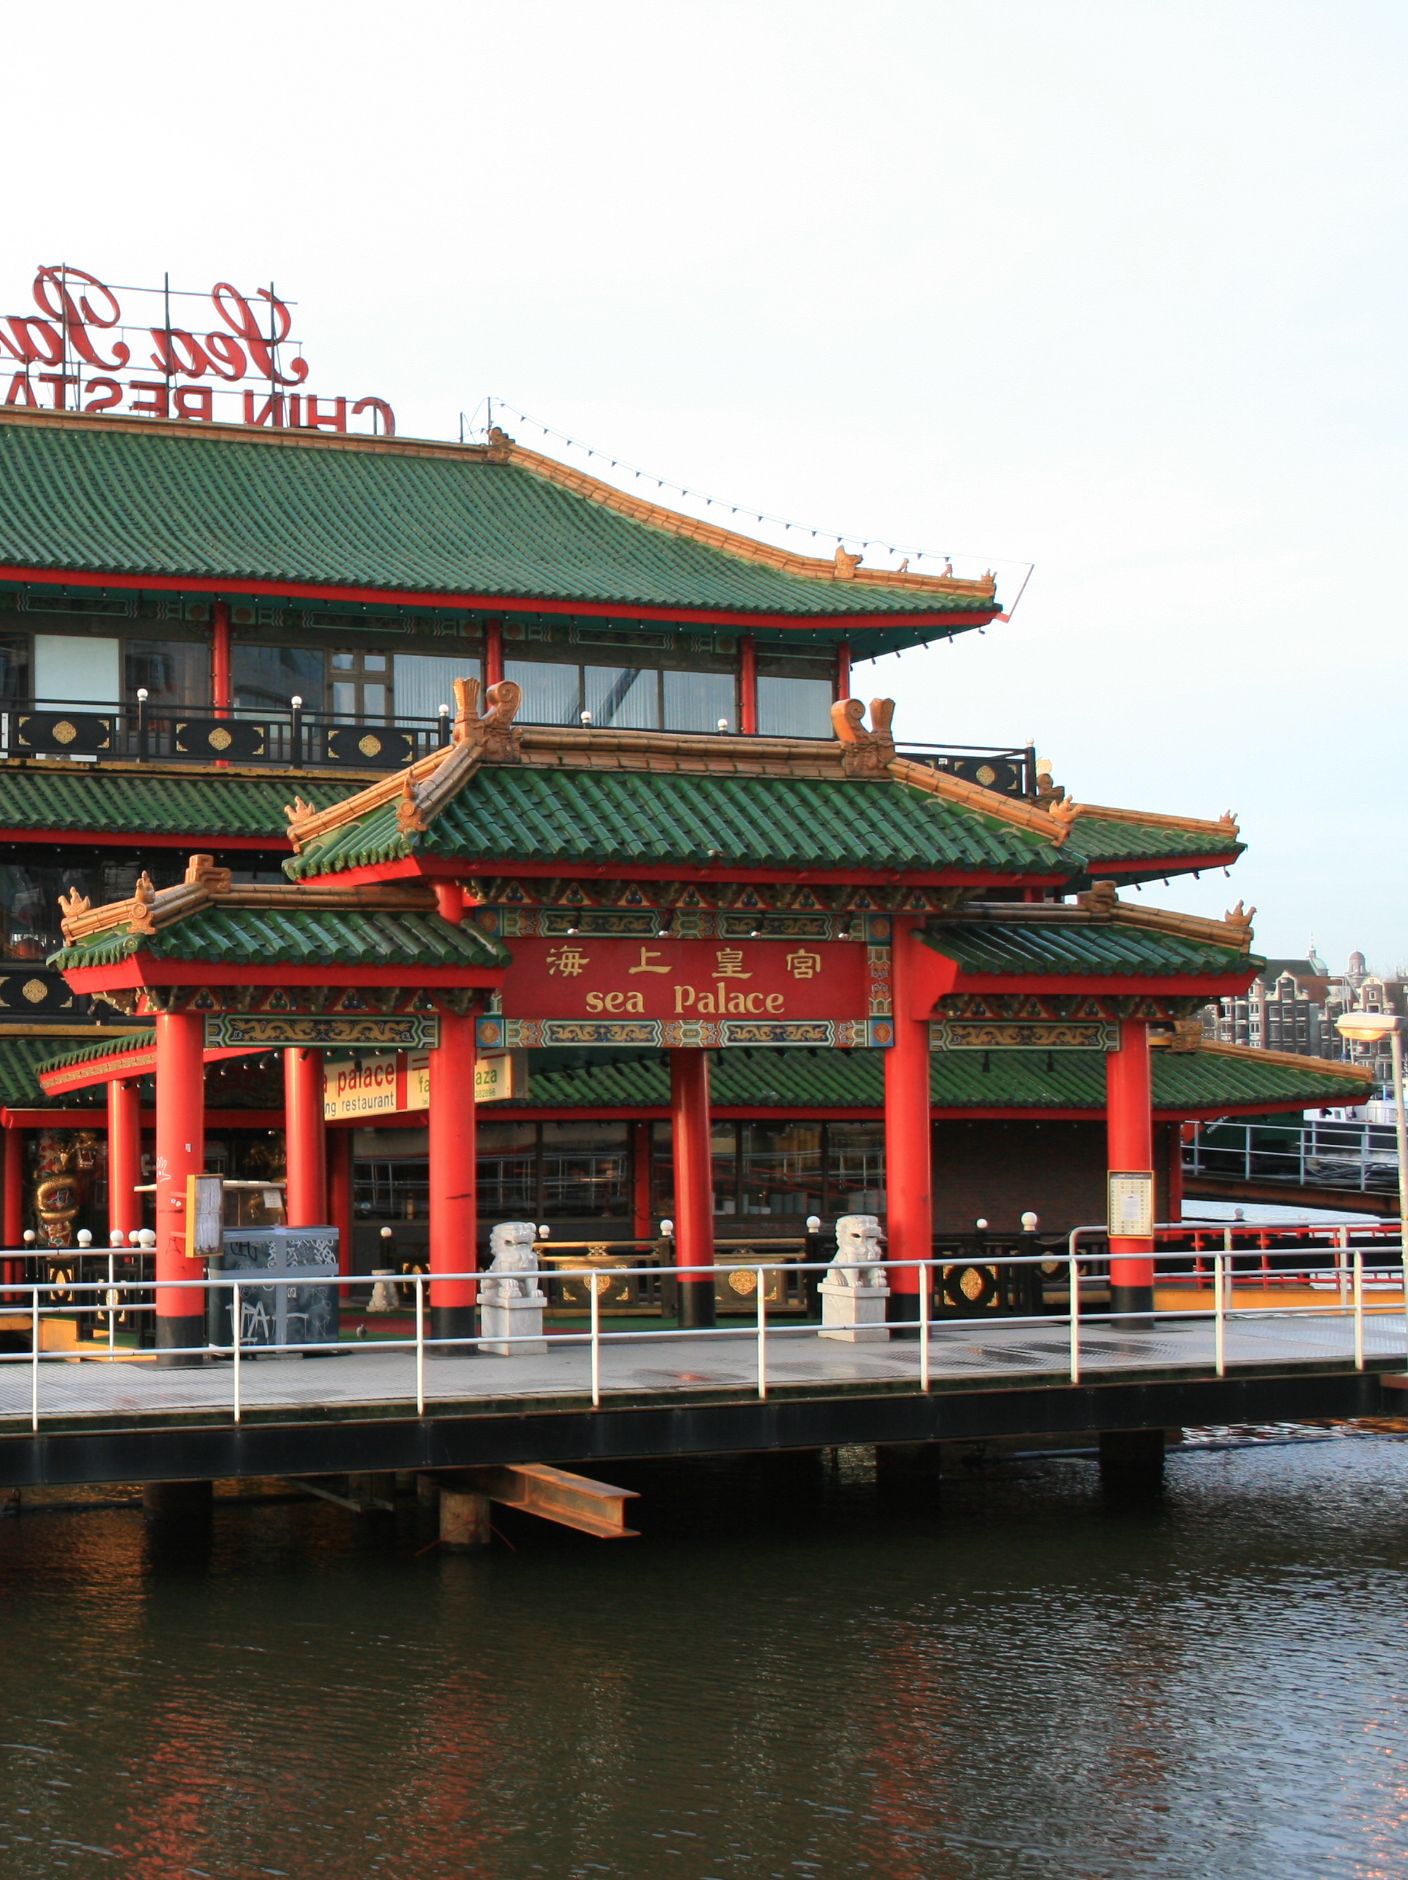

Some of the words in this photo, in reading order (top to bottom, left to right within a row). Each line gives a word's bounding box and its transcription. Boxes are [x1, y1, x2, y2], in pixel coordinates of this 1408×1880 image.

[546, 944, 822, 980] 海上皇宮
[585, 989, 645, 1014] sea
[673, 982, 785, 1015] Palace
[337, 1062, 395, 1098] palace
[341, 1091, 395, 1113] restaurant
